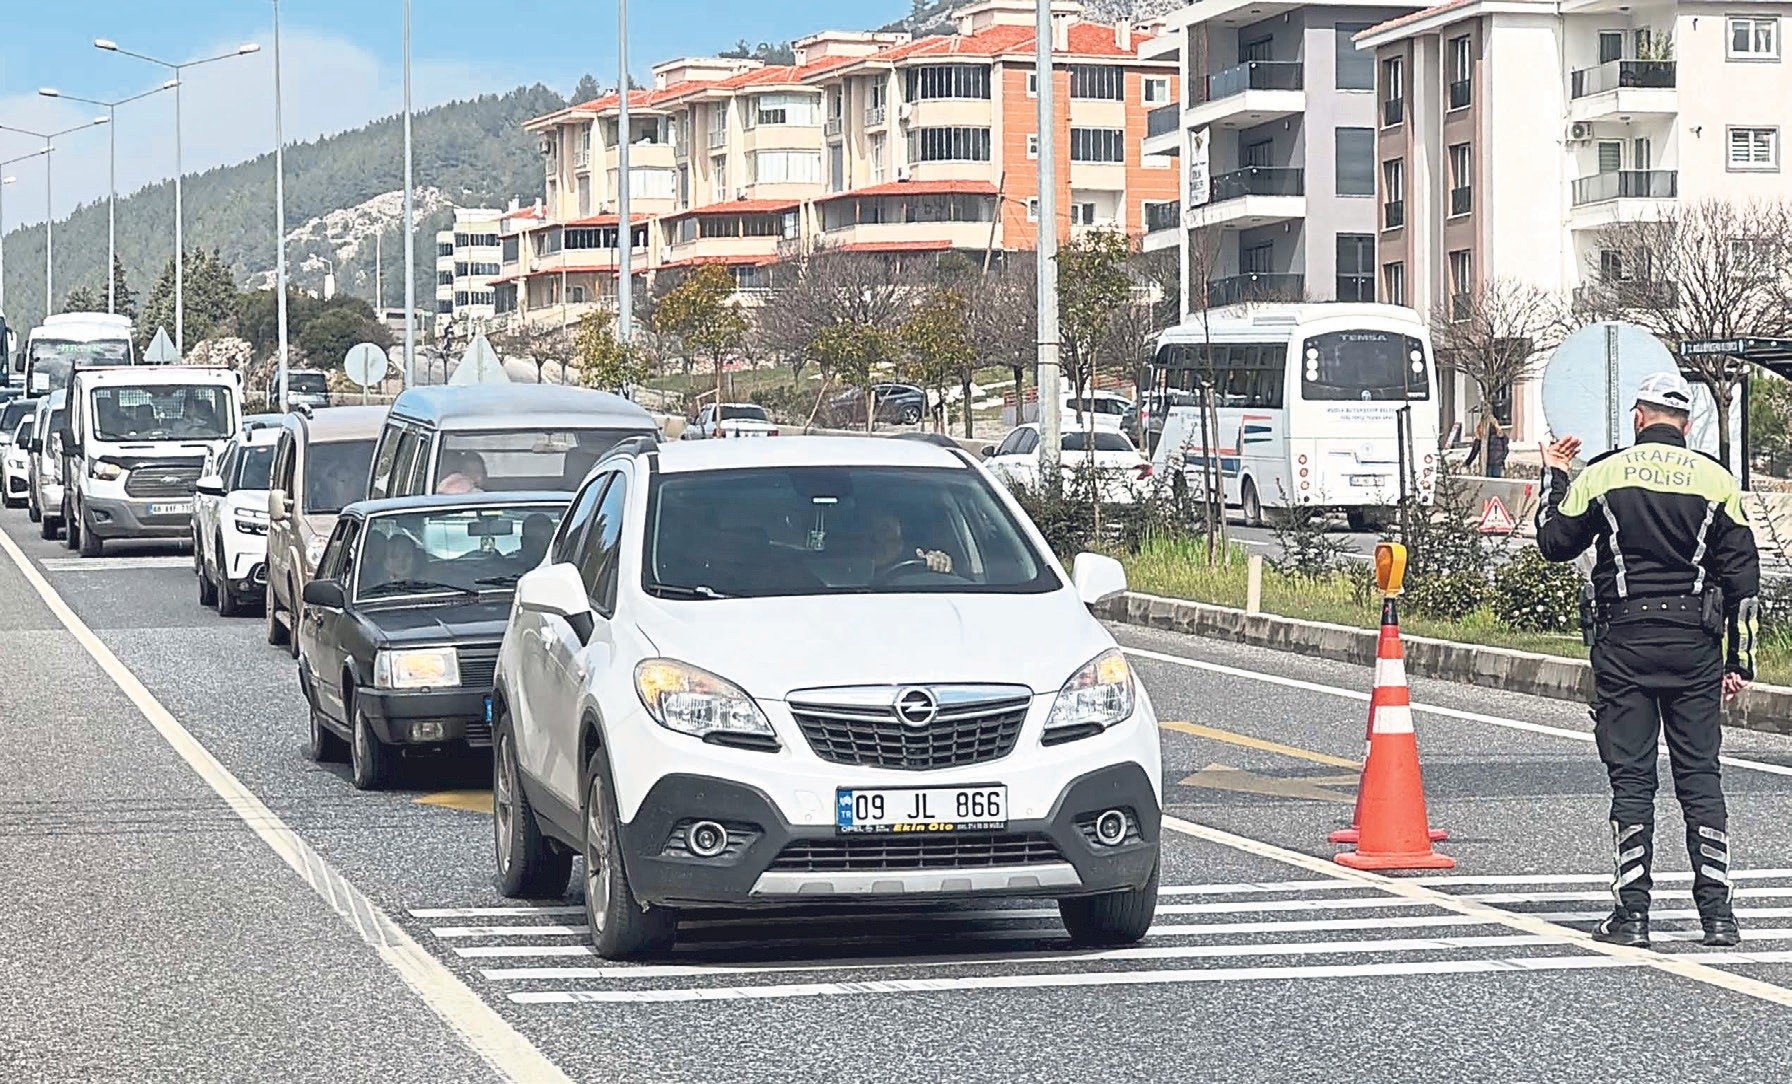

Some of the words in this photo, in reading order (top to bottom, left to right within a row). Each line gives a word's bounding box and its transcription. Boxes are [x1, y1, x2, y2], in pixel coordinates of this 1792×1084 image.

[855, 794, 885, 820] 09
[907, 793, 936, 818] JL
[956, 791, 1000, 817] 866
[841, 810, 851, 819] TR
[893, 822, 925, 832] Ekin
[928, 821, 954, 831] Oto
